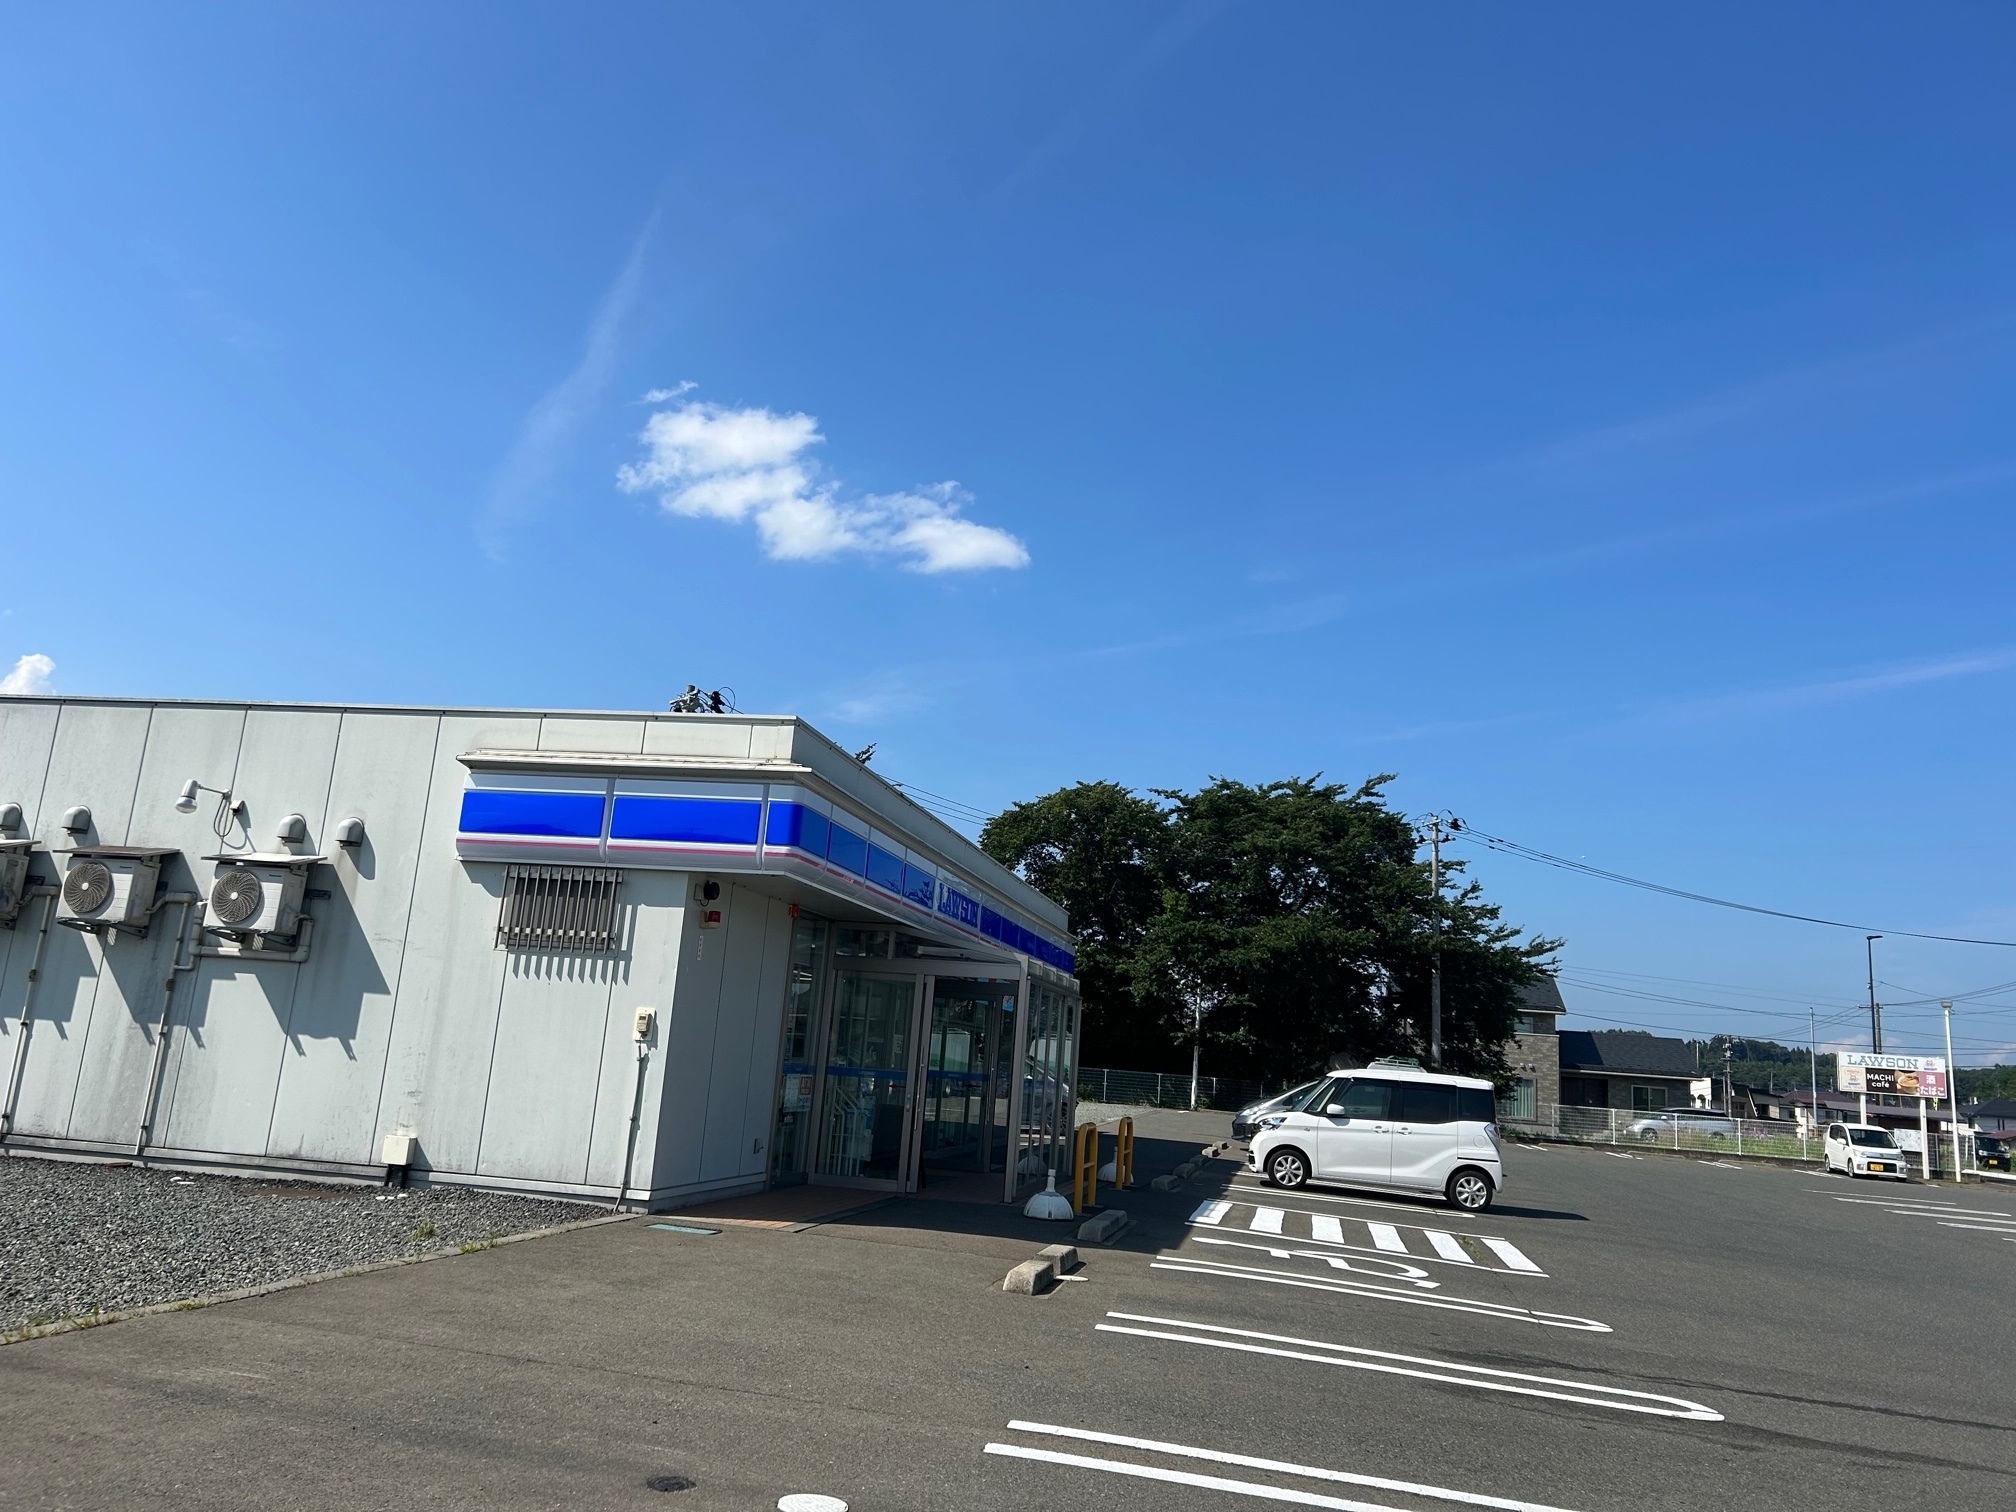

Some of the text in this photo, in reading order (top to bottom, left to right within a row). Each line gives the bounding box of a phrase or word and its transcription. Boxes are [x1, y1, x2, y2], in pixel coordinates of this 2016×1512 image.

[938, 882, 980, 928] LAWSON
[1847, 1054, 1919, 1070] LAWSON
[1867, 1073, 1894, 1082] MACHI
[1926, 1074, 1936, 1085] 酒
[1920, 1085, 1945, 1096] たばこ
